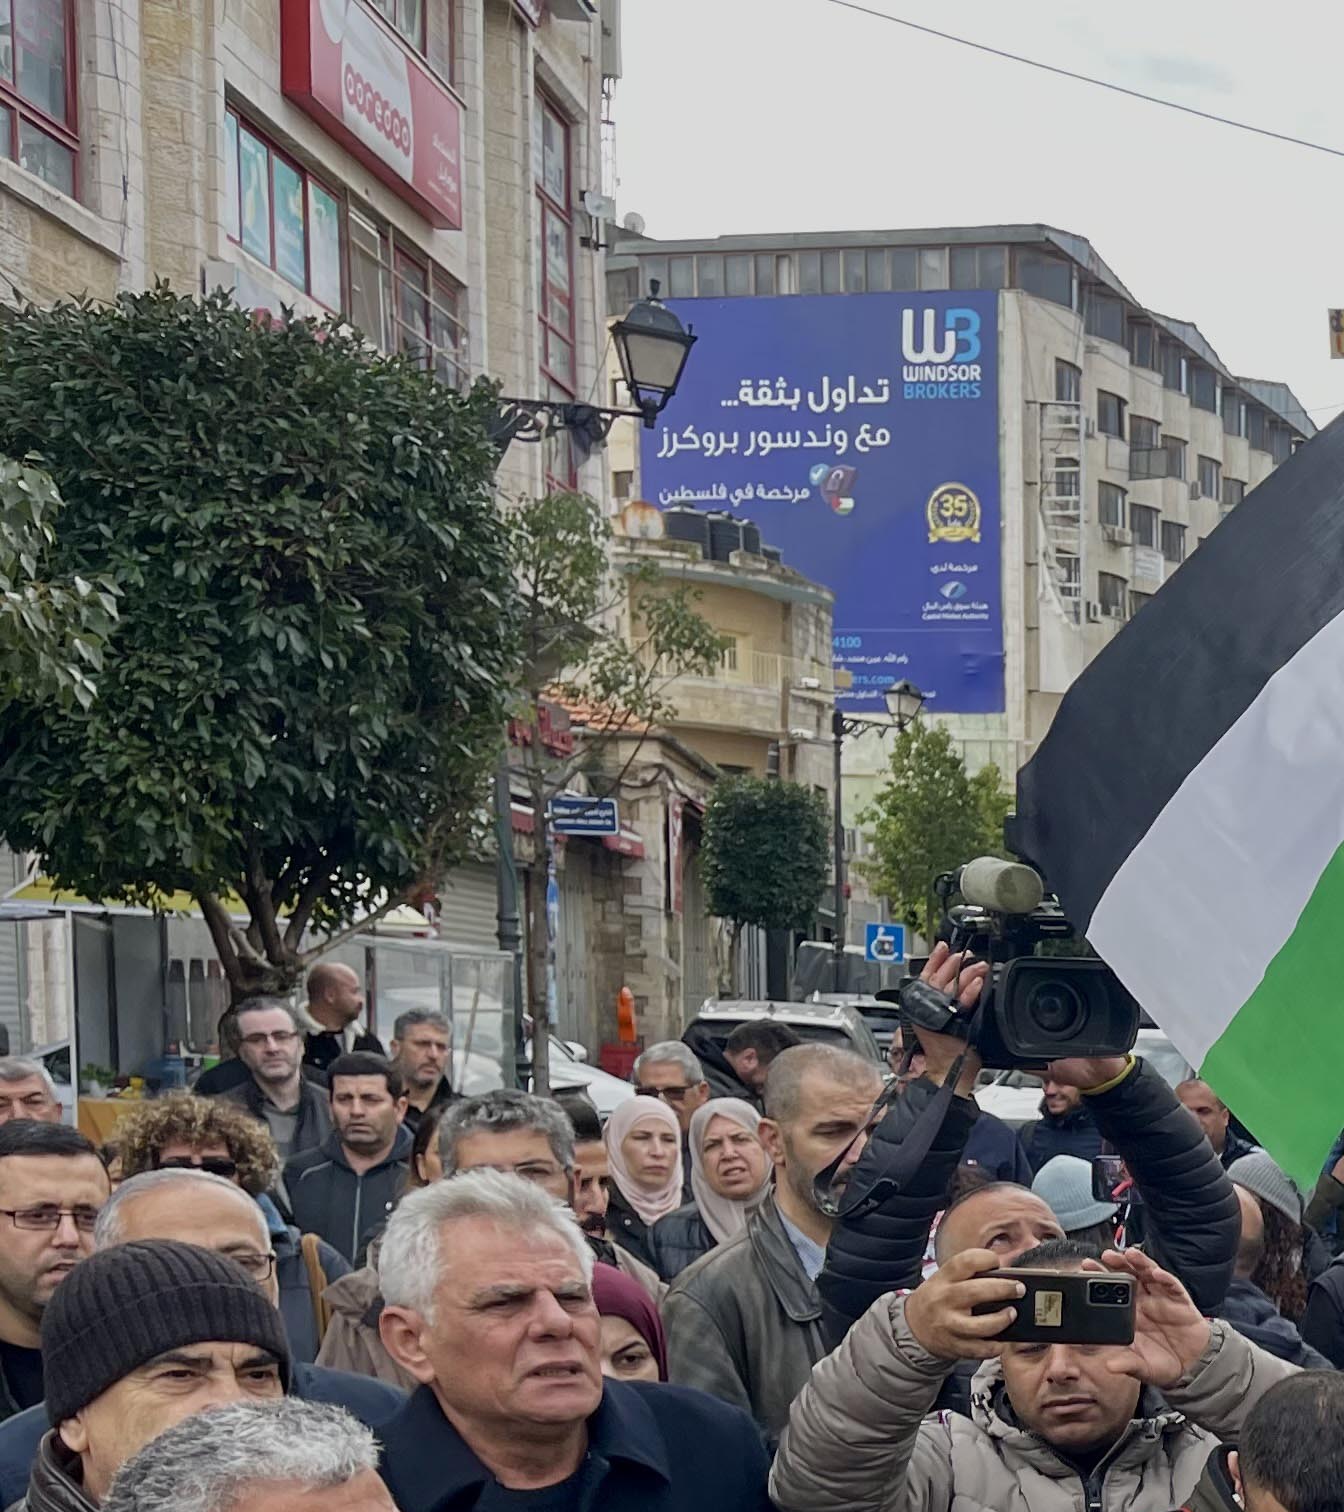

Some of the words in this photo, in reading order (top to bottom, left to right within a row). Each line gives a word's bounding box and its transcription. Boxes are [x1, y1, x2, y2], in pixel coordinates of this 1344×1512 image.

[345, 65, 411, 156] ooredoo
[903, 364, 981, 382] WINDSOR
[807, 375, 890, 413] تداول
[903, 383, 981, 399] BROKERS
[656, 425, 740, 458] بروكرز
[743, 423, 849, 457] وندسور
[854, 423, 891, 452] مع
[658, 483, 728, 505] فلسطين
[729, 482, 755, 507] في
[756, 483, 811, 504] مرخصة
[940, 493, 968, 517] 35
